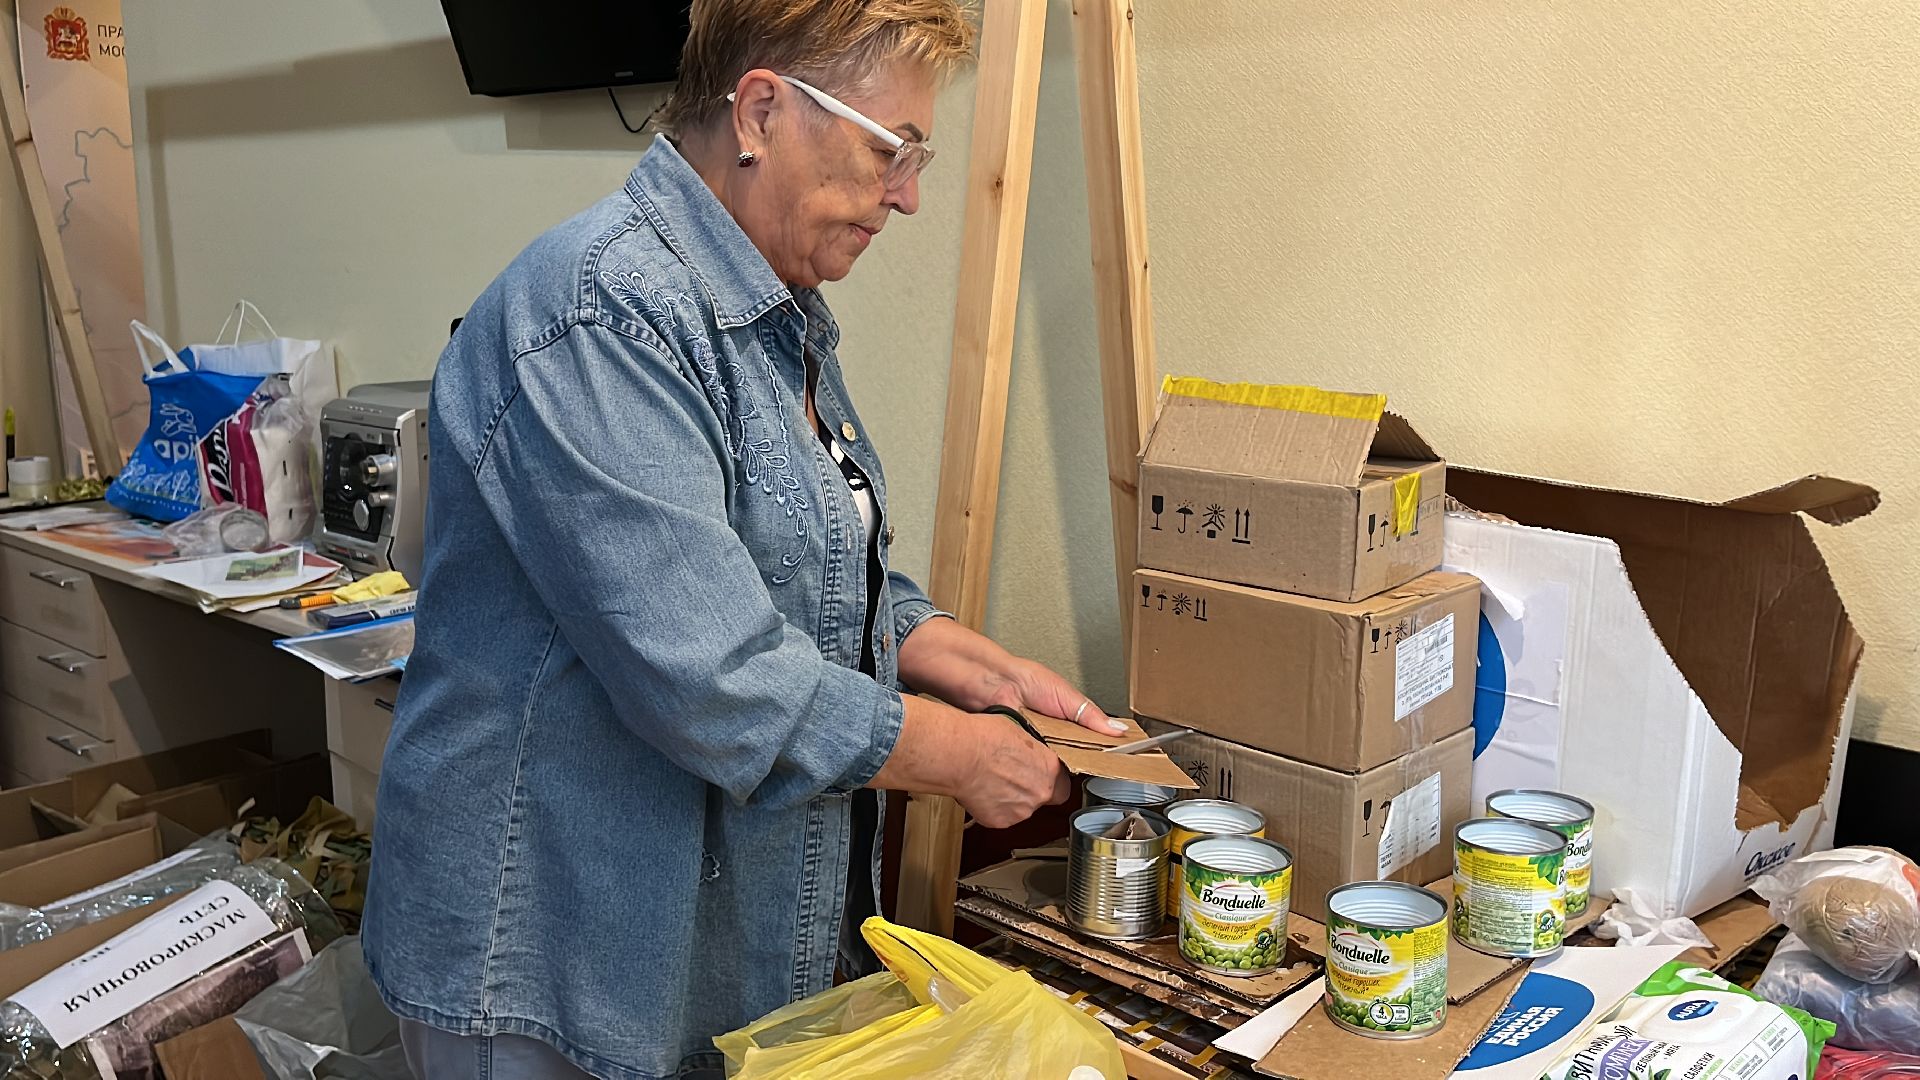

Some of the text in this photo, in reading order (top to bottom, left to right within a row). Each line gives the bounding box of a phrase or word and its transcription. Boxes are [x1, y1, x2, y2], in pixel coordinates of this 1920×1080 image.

[154, 434, 200, 464] api
[178, 895, 230, 925] СЕТЬ
[1202, 888, 1266, 911] Bonduelle
[1214, 912, 1248, 922] Classique
[62, 908, 247, 1013] МАСКИРОВОЧНАЯ
[1330, 933, 1390, 964] Bonduelle
[1338, 961, 1369, 976] Classique
[1378, 1006, 1385, 1016] 4
[1485, 1006, 1546, 1045] ЕДИНАЯ
[1501, 1007, 1564, 1047] РОССИЯ
[1603, 1038, 1650, 1080] ОМПЛЕК
[1683, 1051, 1716, 1080] САЛФЕТКИ
